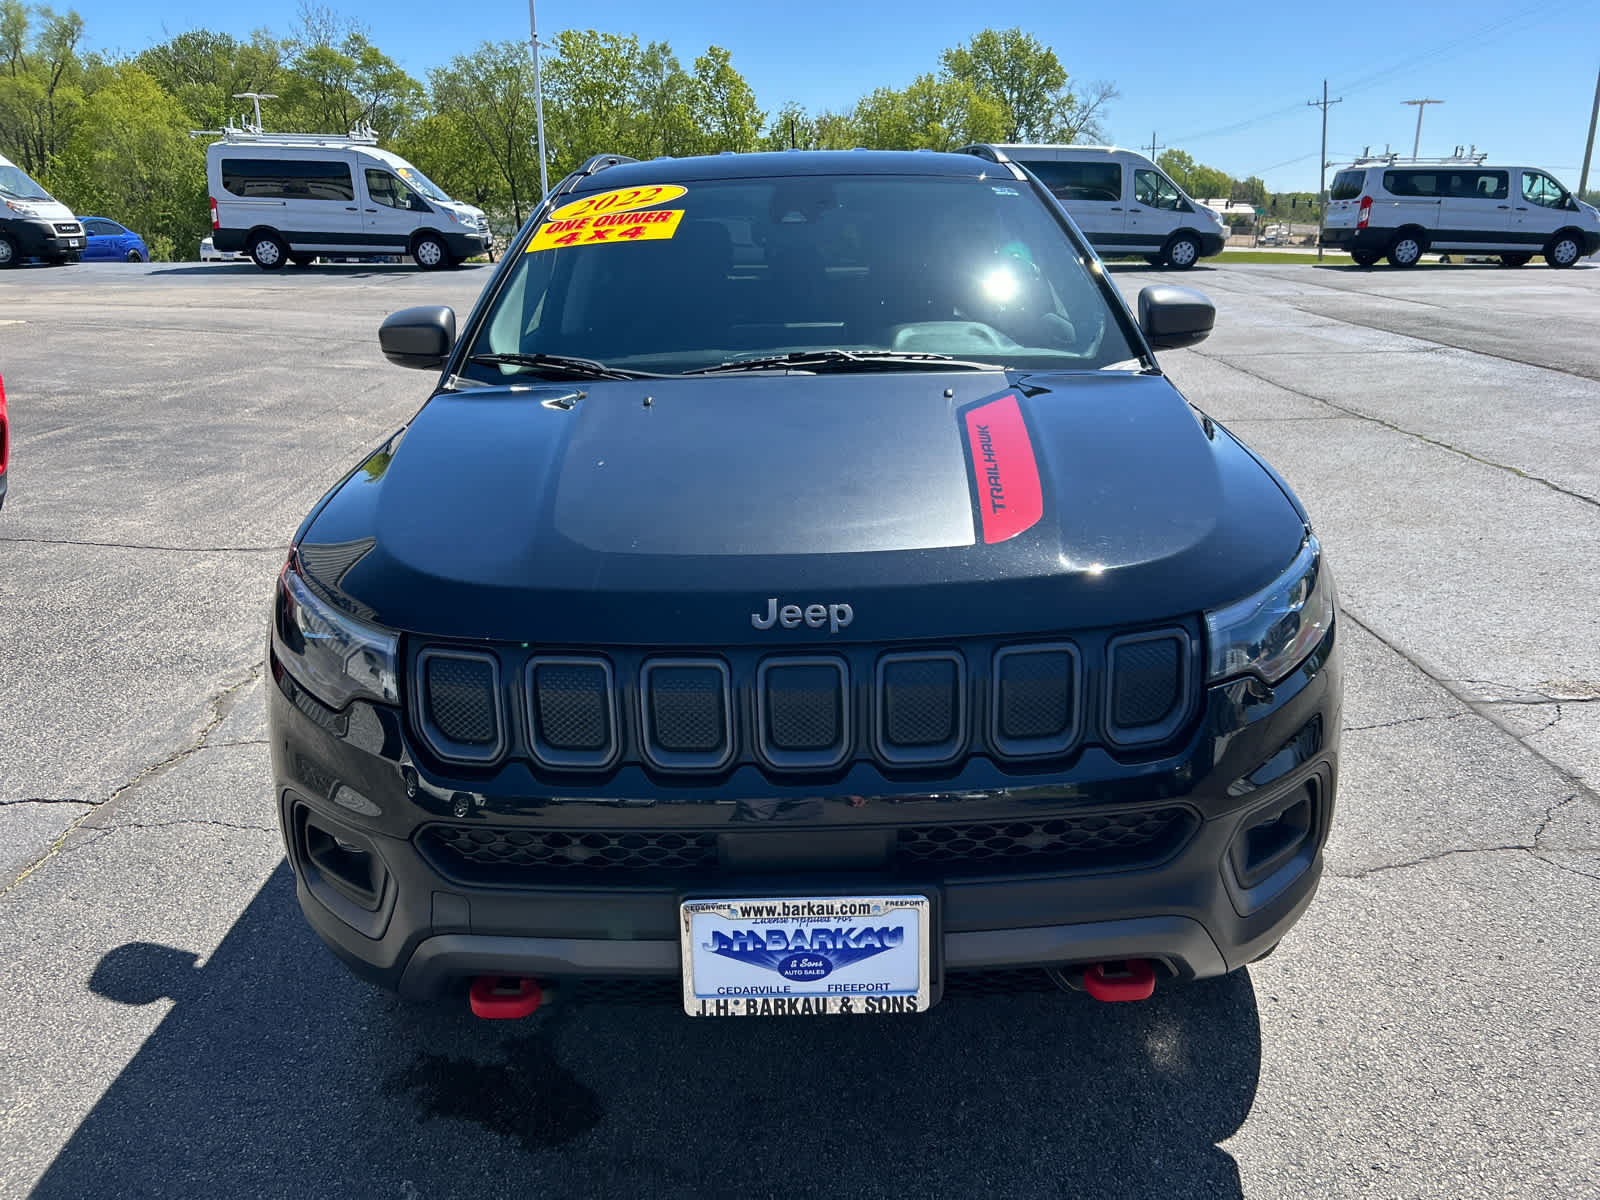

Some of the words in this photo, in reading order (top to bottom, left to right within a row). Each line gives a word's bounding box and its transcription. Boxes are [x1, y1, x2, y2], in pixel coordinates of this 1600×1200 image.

[569, 187, 663, 217] 2022
[545, 217, 593, 235] ONE
[592, 210, 674, 228] OWNER
[976, 424, 1006, 515] TRAILHAWK
[751, 598, 854, 633] Jeep
[740, 901, 871, 917] www.barkau.com
[717, 985, 791, 995] CEDARVILLE
[827, 982, 891, 992] FREEPORT
[745, 996, 828, 1015] BARKAU
[839, 995, 854, 1014] &
[864, 995, 918, 1013] SONS
